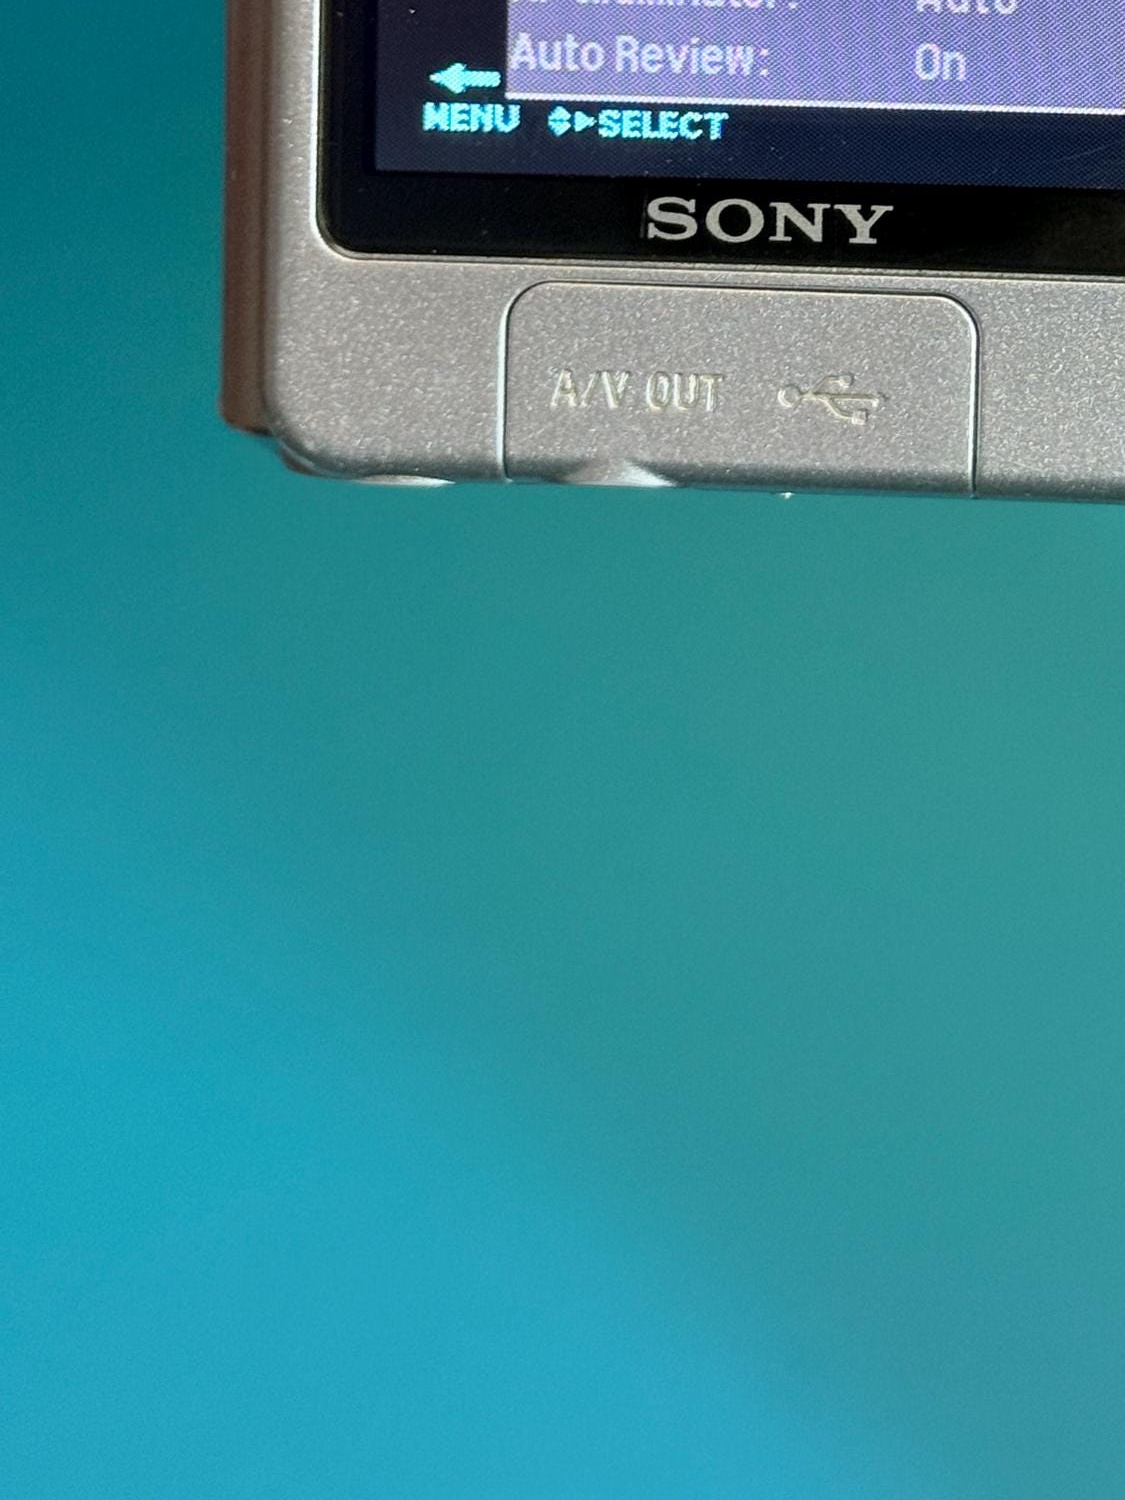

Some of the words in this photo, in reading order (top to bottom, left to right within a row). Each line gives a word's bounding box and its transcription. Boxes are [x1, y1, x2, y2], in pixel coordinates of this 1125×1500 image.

[510, 32, 605, 73] Auto
[614, 35, 769, 77] Review:
[914, 43, 967, 81] On
[422, 102, 521, 133] MENU
[598, 108, 729, 140] SELECT
[646, 196, 893, 245] SONY
[549, 368, 631, 410] A/V
[645, 370, 725, 413] OUT
